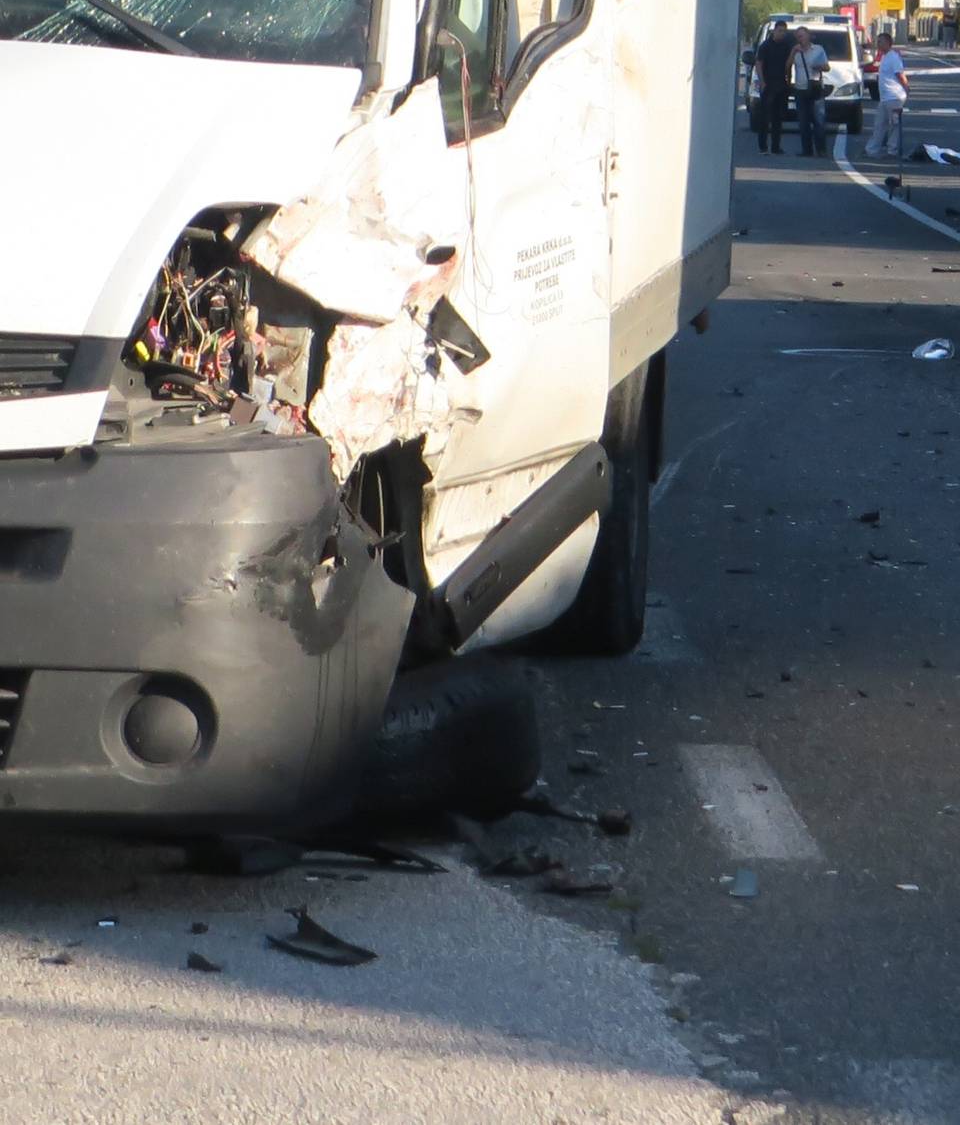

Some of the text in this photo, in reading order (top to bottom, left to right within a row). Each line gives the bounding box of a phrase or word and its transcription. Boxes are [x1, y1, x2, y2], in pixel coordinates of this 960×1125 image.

[516, 244, 541, 263] PEKARA
[542, 238, 558, 254] KRKA
[513, 249, 576, 281] PRIJEVOZ ZA VLASTITE
[535, 274, 559, 293] POTREBE
